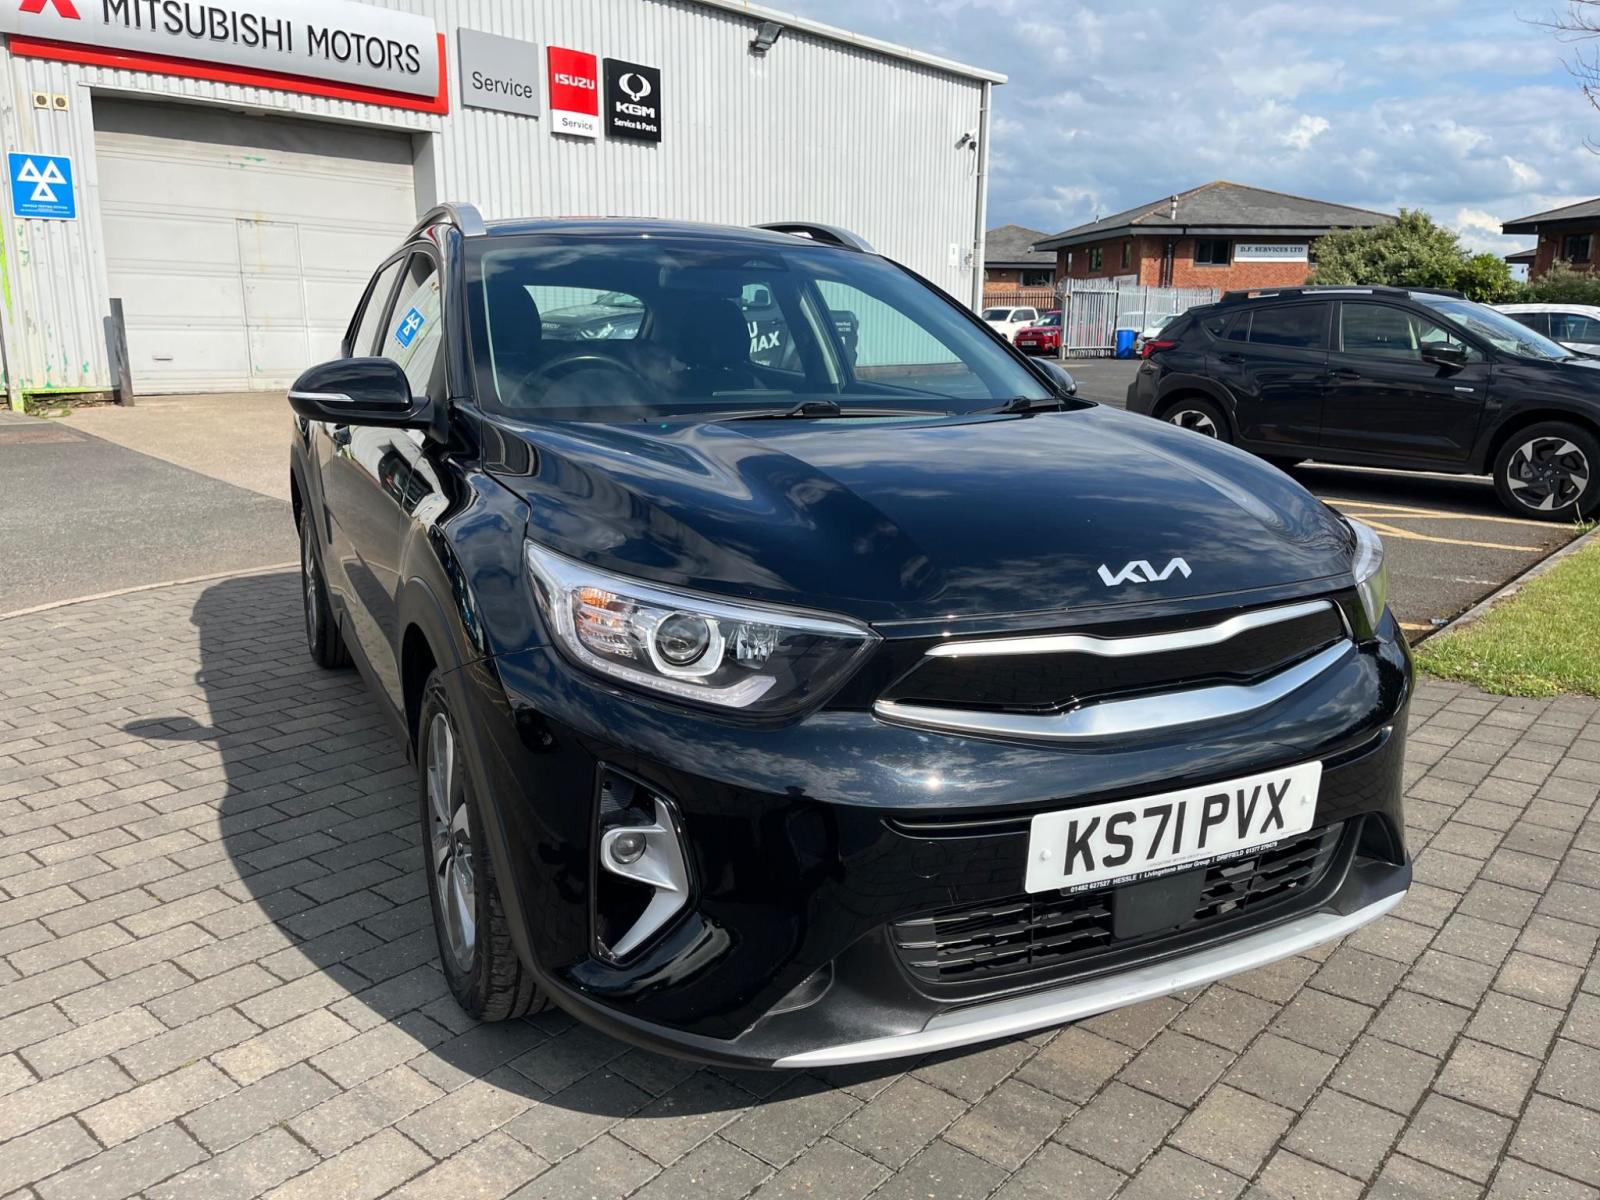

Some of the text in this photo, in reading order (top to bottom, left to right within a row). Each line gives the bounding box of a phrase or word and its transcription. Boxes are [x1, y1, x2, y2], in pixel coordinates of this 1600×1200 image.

[102, 0, 420, 74] MITSUBISHI MOTORS
[472, 71, 533, 98] Service
[554, 73, 595, 90] ISUZU
[615, 101, 655, 118] KGM
[561, 117, 593, 130] Service
[613, 117, 636, 128] Service
[641, 122, 657, 132] Parts
[1097, 557, 1192, 587] KIA
[1063, 778, 1292, 876] KS71 PVX
[1112, 874, 1137, 884] HESSLE
[1177, 862, 1193, 870] Motor
[1193, 859, 1211, 868] Group
